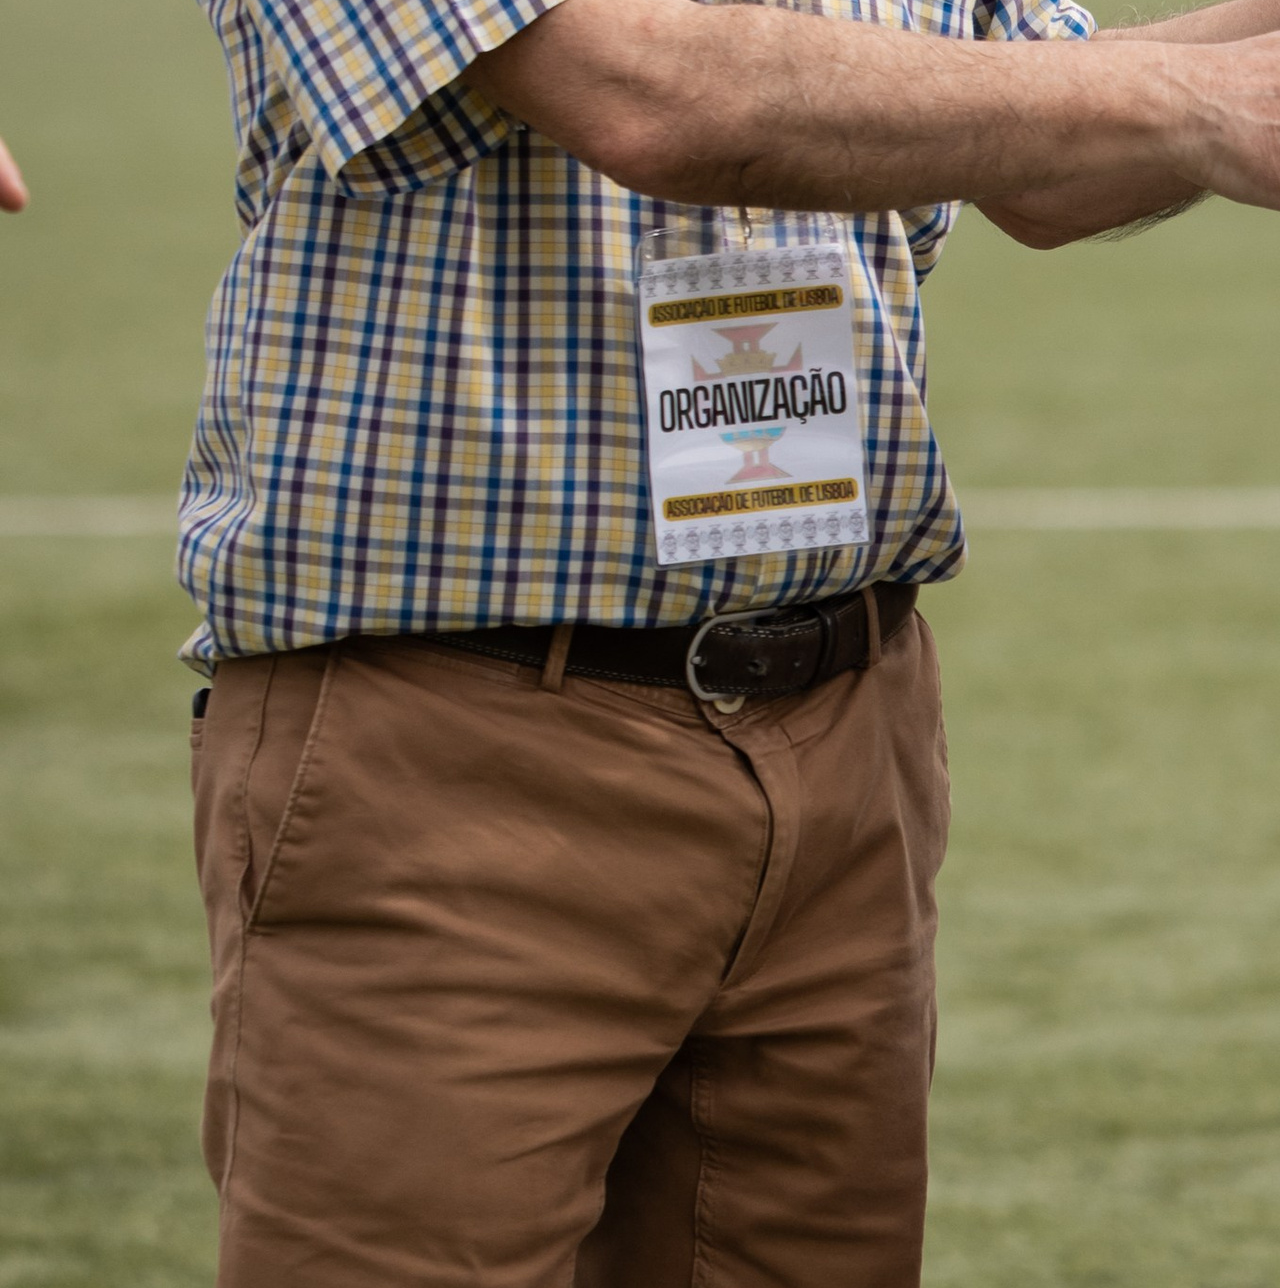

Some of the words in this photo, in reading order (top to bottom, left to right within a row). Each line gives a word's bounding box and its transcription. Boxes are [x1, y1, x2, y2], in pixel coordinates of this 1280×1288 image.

[652, 298, 715, 323] ASSOCIAÇÃO
[718, 297, 732, 315] DE
[734, 293, 780, 313] FUTEBOL
[783, 291, 797, 309] DE
[799, 287, 839, 307] LISBOA
[659, 368, 847, 433] ORGANIZAÇÃO
[667, 493, 732, 517] ASSOCIAÇÃO
[735, 492, 750, 510] DE
[752, 487, 797, 508] FUTEBOL
[800, 485, 814, 503] DE
[815, 480, 854, 501] LISBOA
